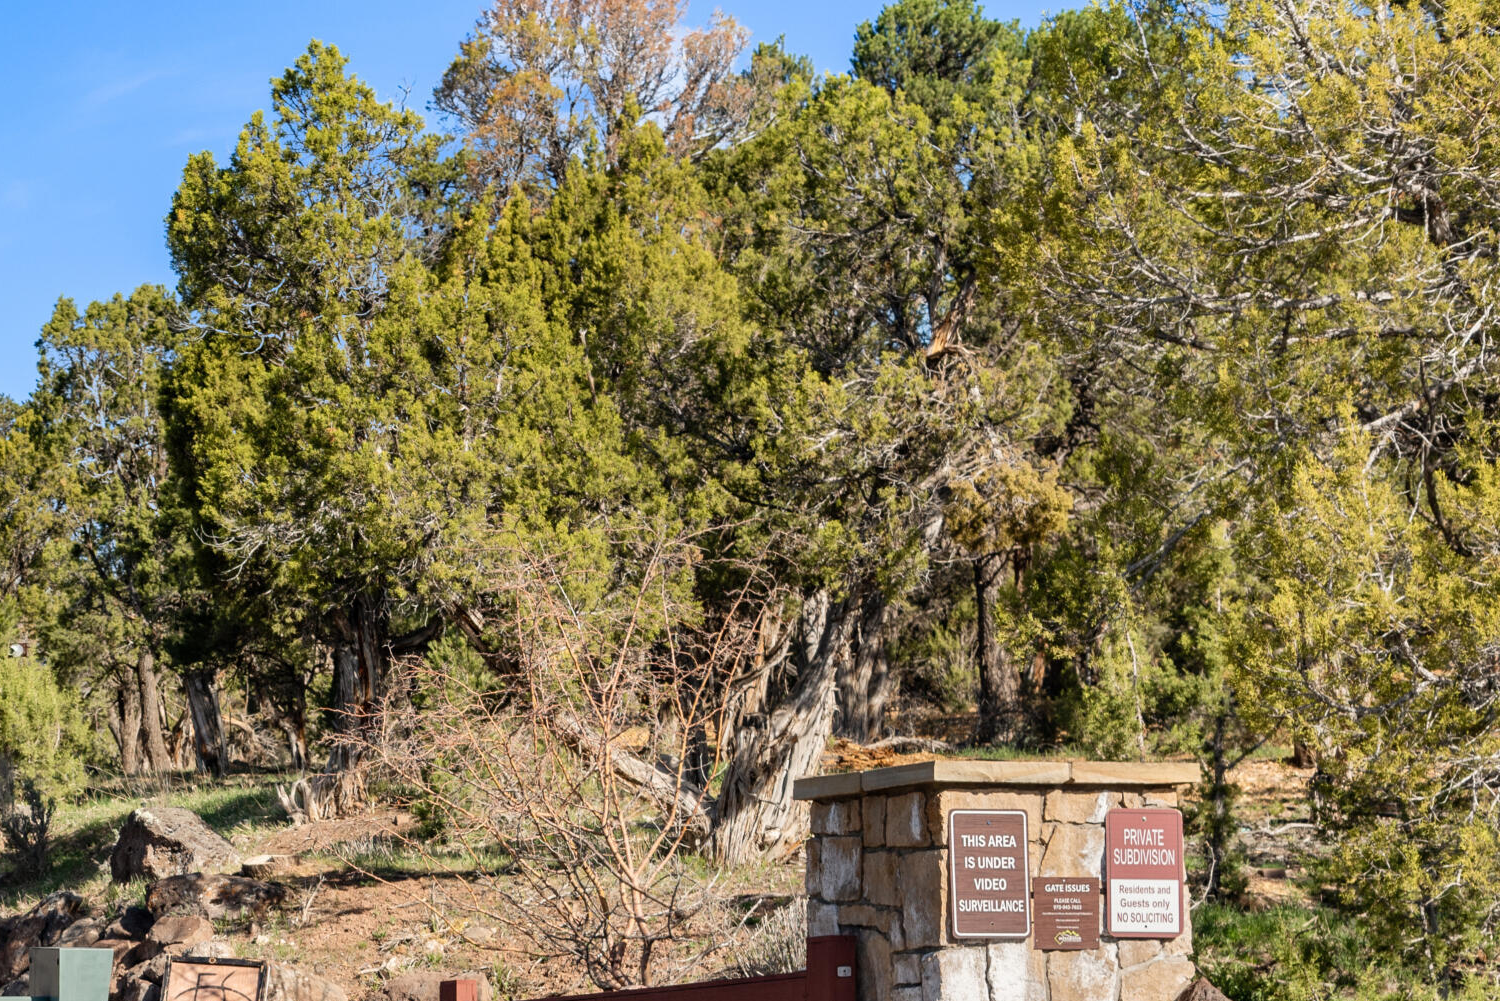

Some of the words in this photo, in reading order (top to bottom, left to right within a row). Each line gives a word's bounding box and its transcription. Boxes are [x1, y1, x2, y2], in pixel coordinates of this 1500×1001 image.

[961, 834, 986, 847] THIS
[988, 835, 1017, 848] AREA
[1123, 828, 1164, 846] PRIVATE
[964, 856, 975, 869] IS
[977, 857, 1015, 869] UNDER
[1113, 848, 1175, 866] SUBDIVISION
[973, 878, 1007, 891] VIDEO
[1044, 884, 1064, 893] GATE
[1065, 884, 1090, 893] ISSUES
[1119, 885, 1155, 894] Residents
[1157, 886, 1171, 894] and
[959, 899, 1024, 912] SURVEILLANCE
[1120, 898, 1149, 908] Guests
[1152, 899, 1170, 910] only
[1117, 912, 1129, 923] NO
[1130, 912, 1173, 923] SOLICITING
